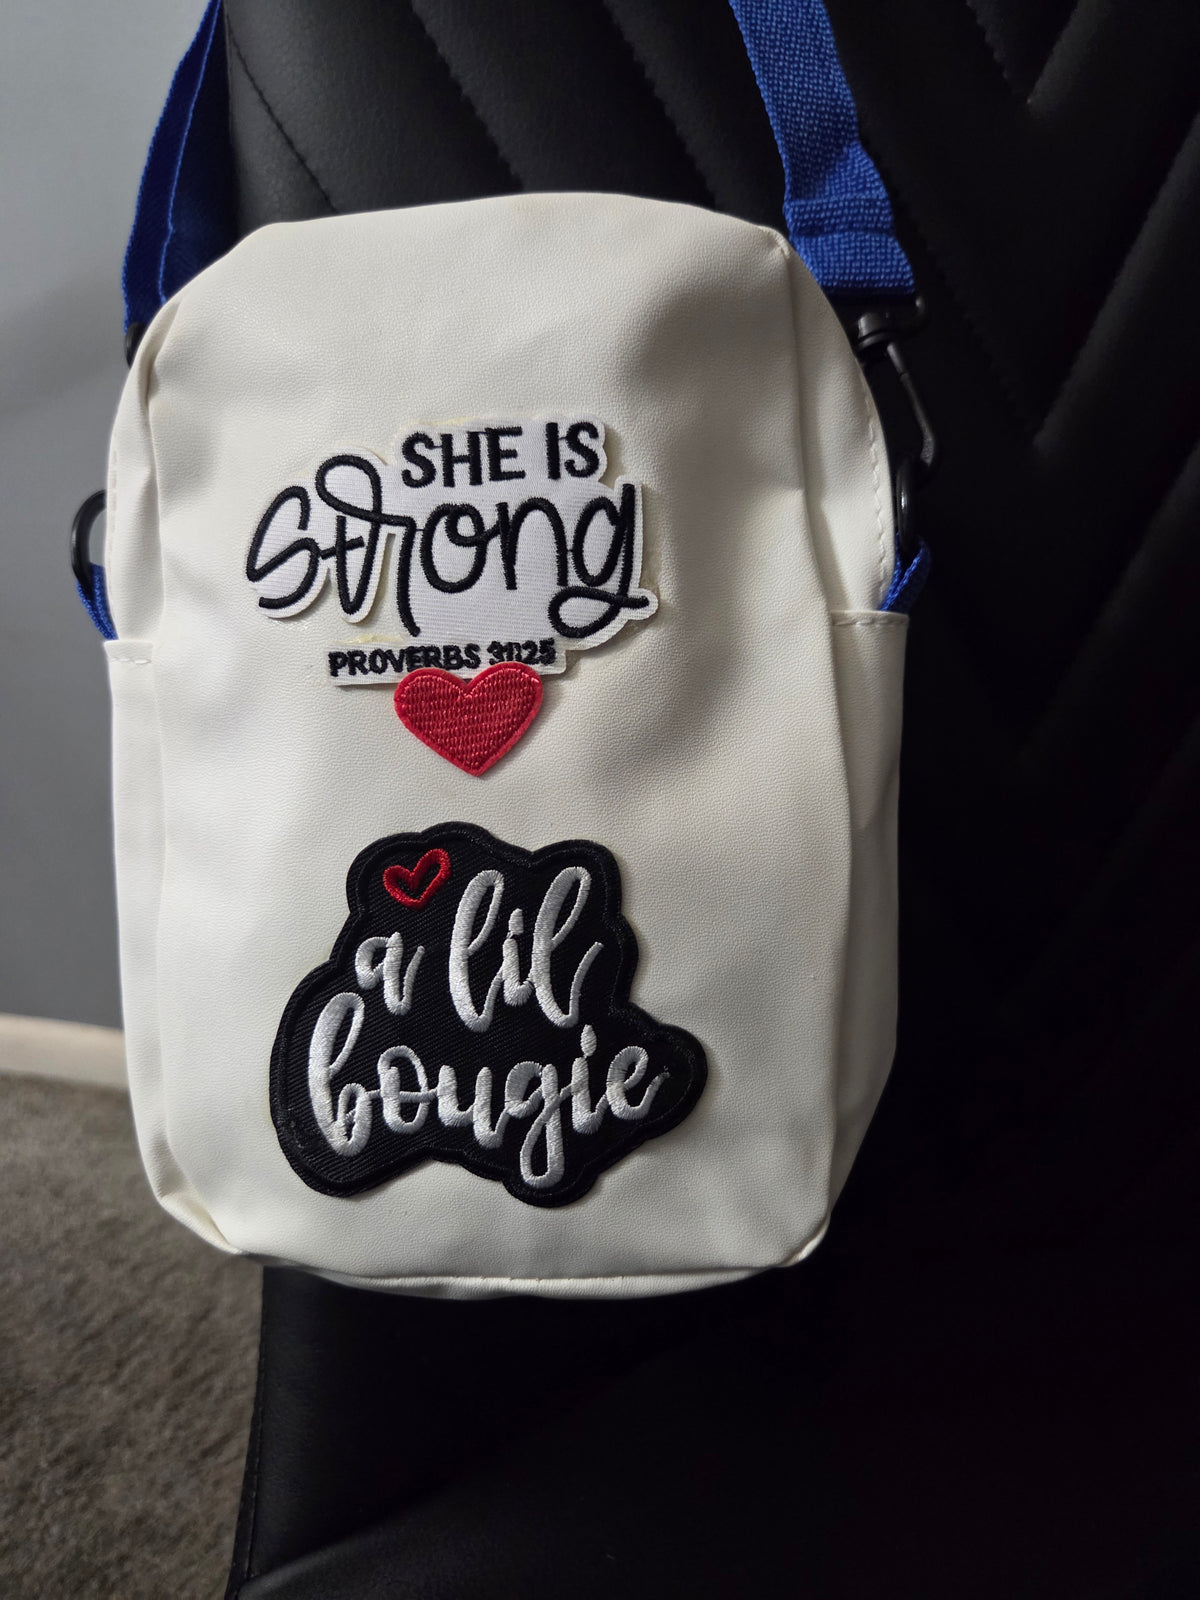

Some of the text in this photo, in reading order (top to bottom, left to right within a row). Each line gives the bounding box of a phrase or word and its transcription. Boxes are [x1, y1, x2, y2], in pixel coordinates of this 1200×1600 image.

[401, 421, 600, 488] SHE IS
[328, 643, 481, 677] PROVERBS
[355, 866, 604, 1032] a lil
[308, 992, 671, 1188] bougie
